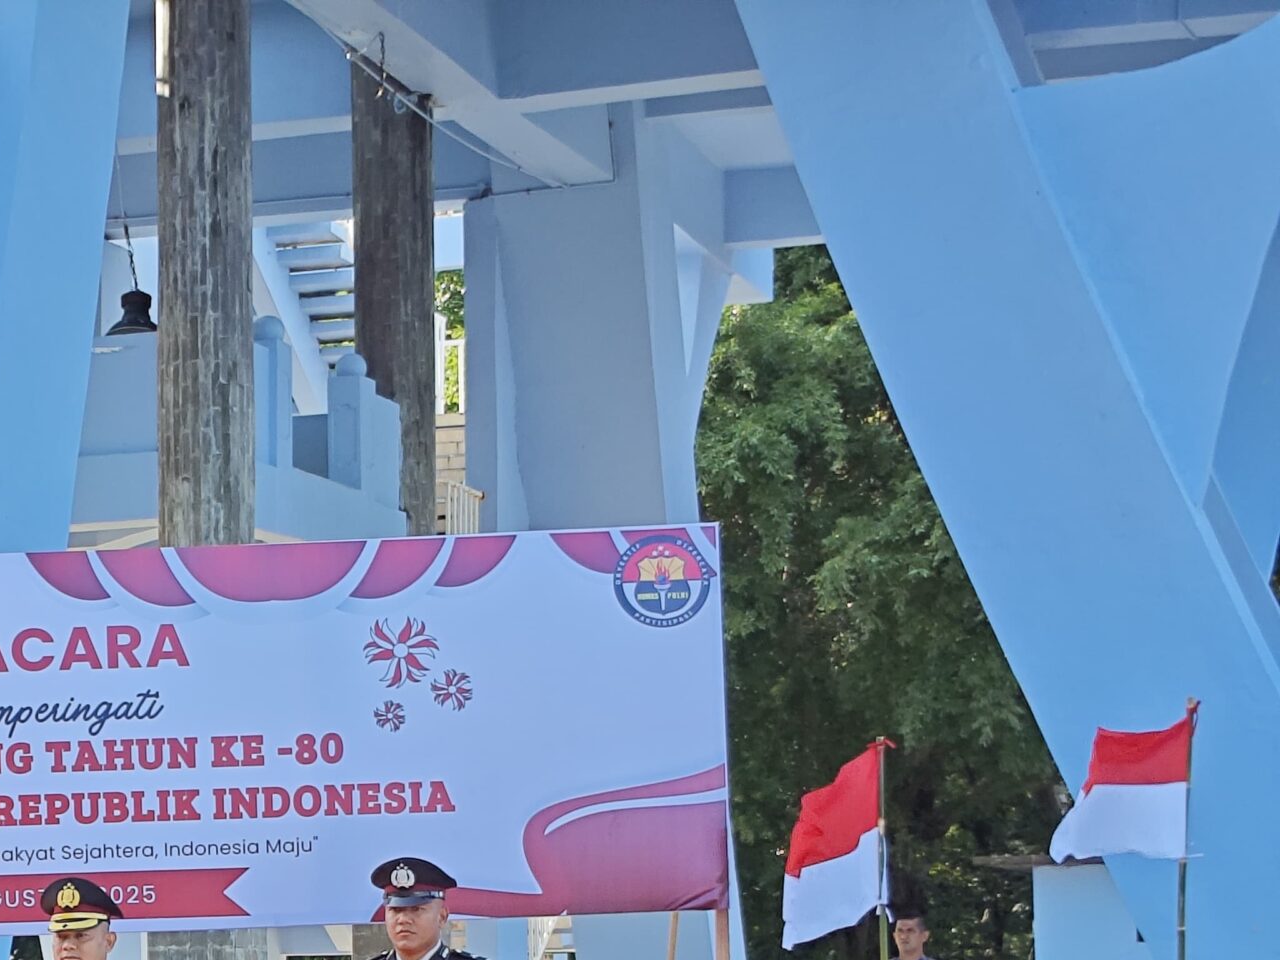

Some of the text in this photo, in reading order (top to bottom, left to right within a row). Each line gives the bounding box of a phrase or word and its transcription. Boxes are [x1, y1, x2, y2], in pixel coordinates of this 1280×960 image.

[45, 736, 199, 773] TAHUN
[210, 734, 265, 768] KE
[277, 732, 345, 765] -80
[212, 780, 456, 820] INDONESIA
[61, 844, 158, 865] Sejahtera,
[164, 839, 260, 857] Indonesia
[265, 835, 319, 858] Maju"
